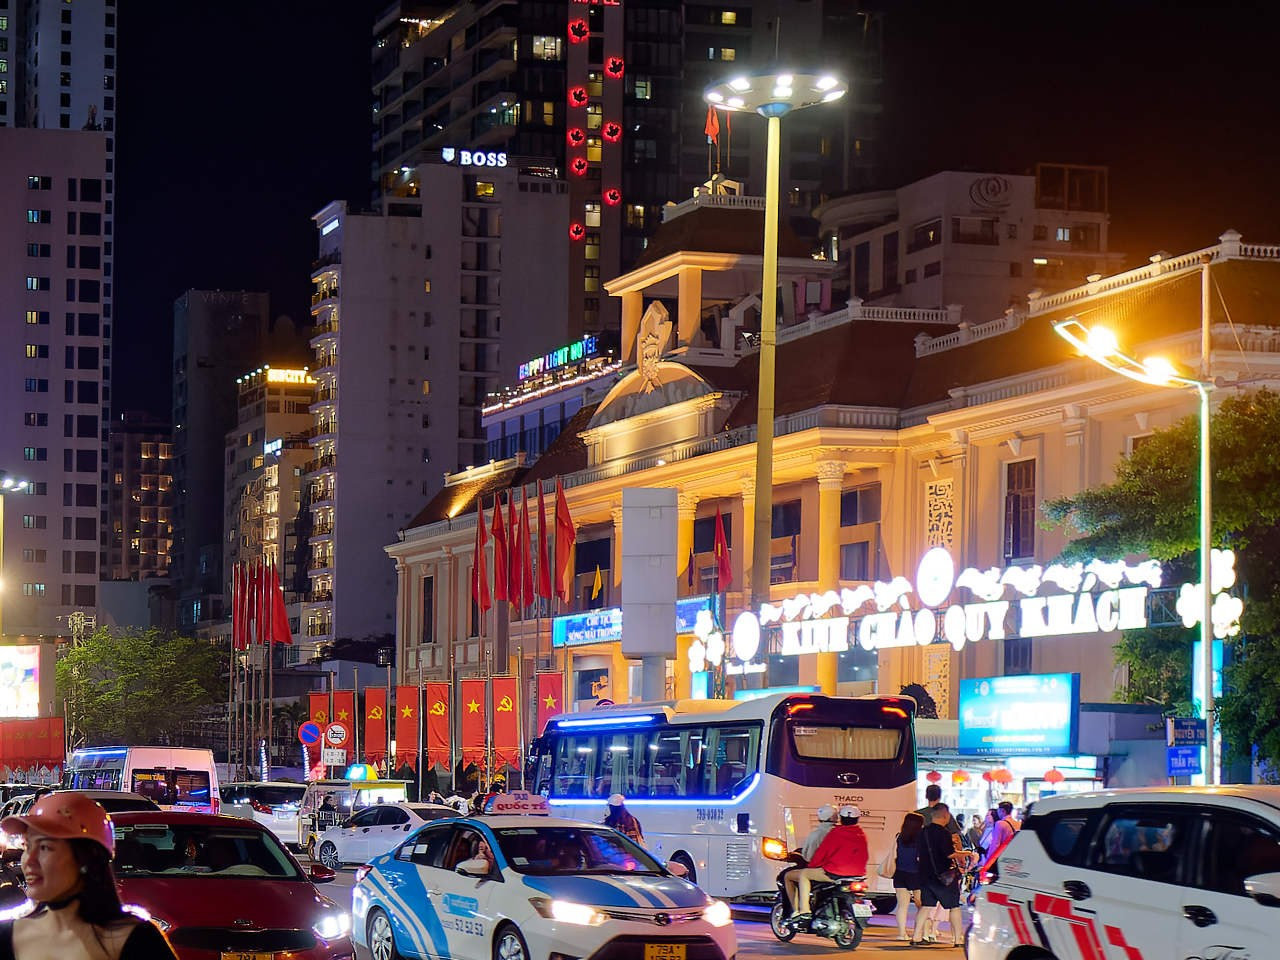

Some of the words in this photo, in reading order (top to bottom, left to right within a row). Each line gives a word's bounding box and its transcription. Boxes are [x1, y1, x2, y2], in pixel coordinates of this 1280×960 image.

[460, 150, 507, 167] BOSS
[545, 346, 569, 370] LIGHT
[570, 336, 597, 361] HOTEL
[1019, 571, 1149, 638] KHÁCH
